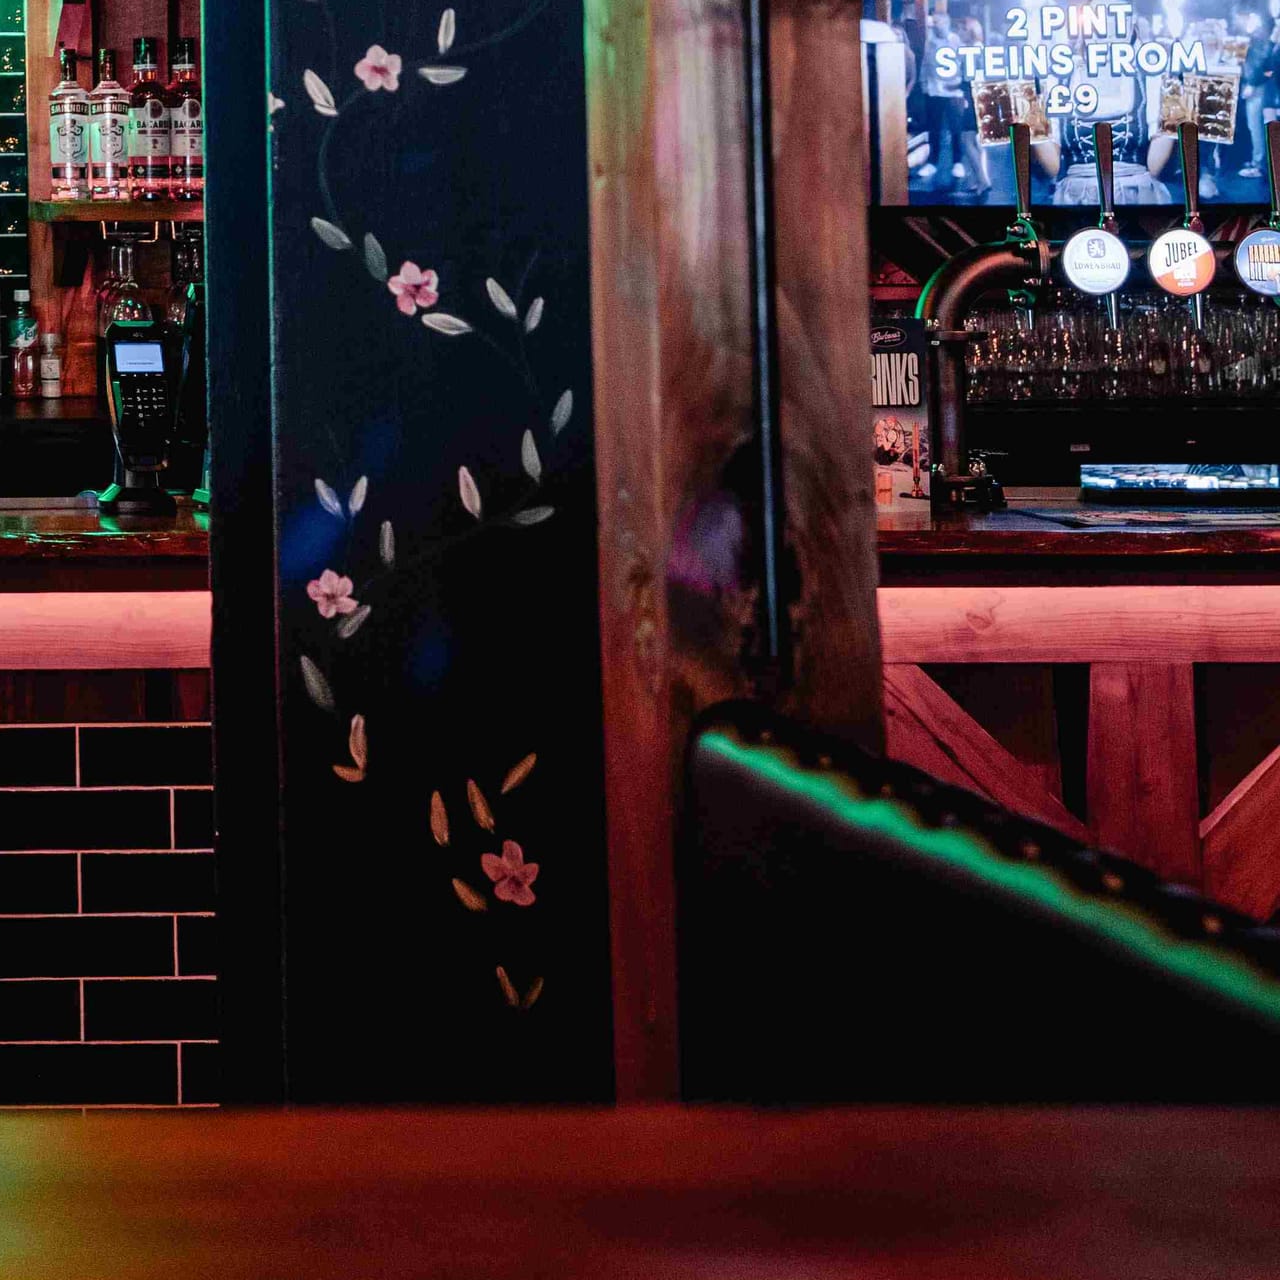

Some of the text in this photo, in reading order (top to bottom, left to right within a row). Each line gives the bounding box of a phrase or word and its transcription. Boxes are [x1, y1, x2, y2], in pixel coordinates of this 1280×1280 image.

[1005, 4, 1133, 40] 2 PINT
[934, 40, 1208, 80] STEINS FROM
[1046, 83, 1100, 117] £9
[1164, 241, 1198, 268] JUBEL
